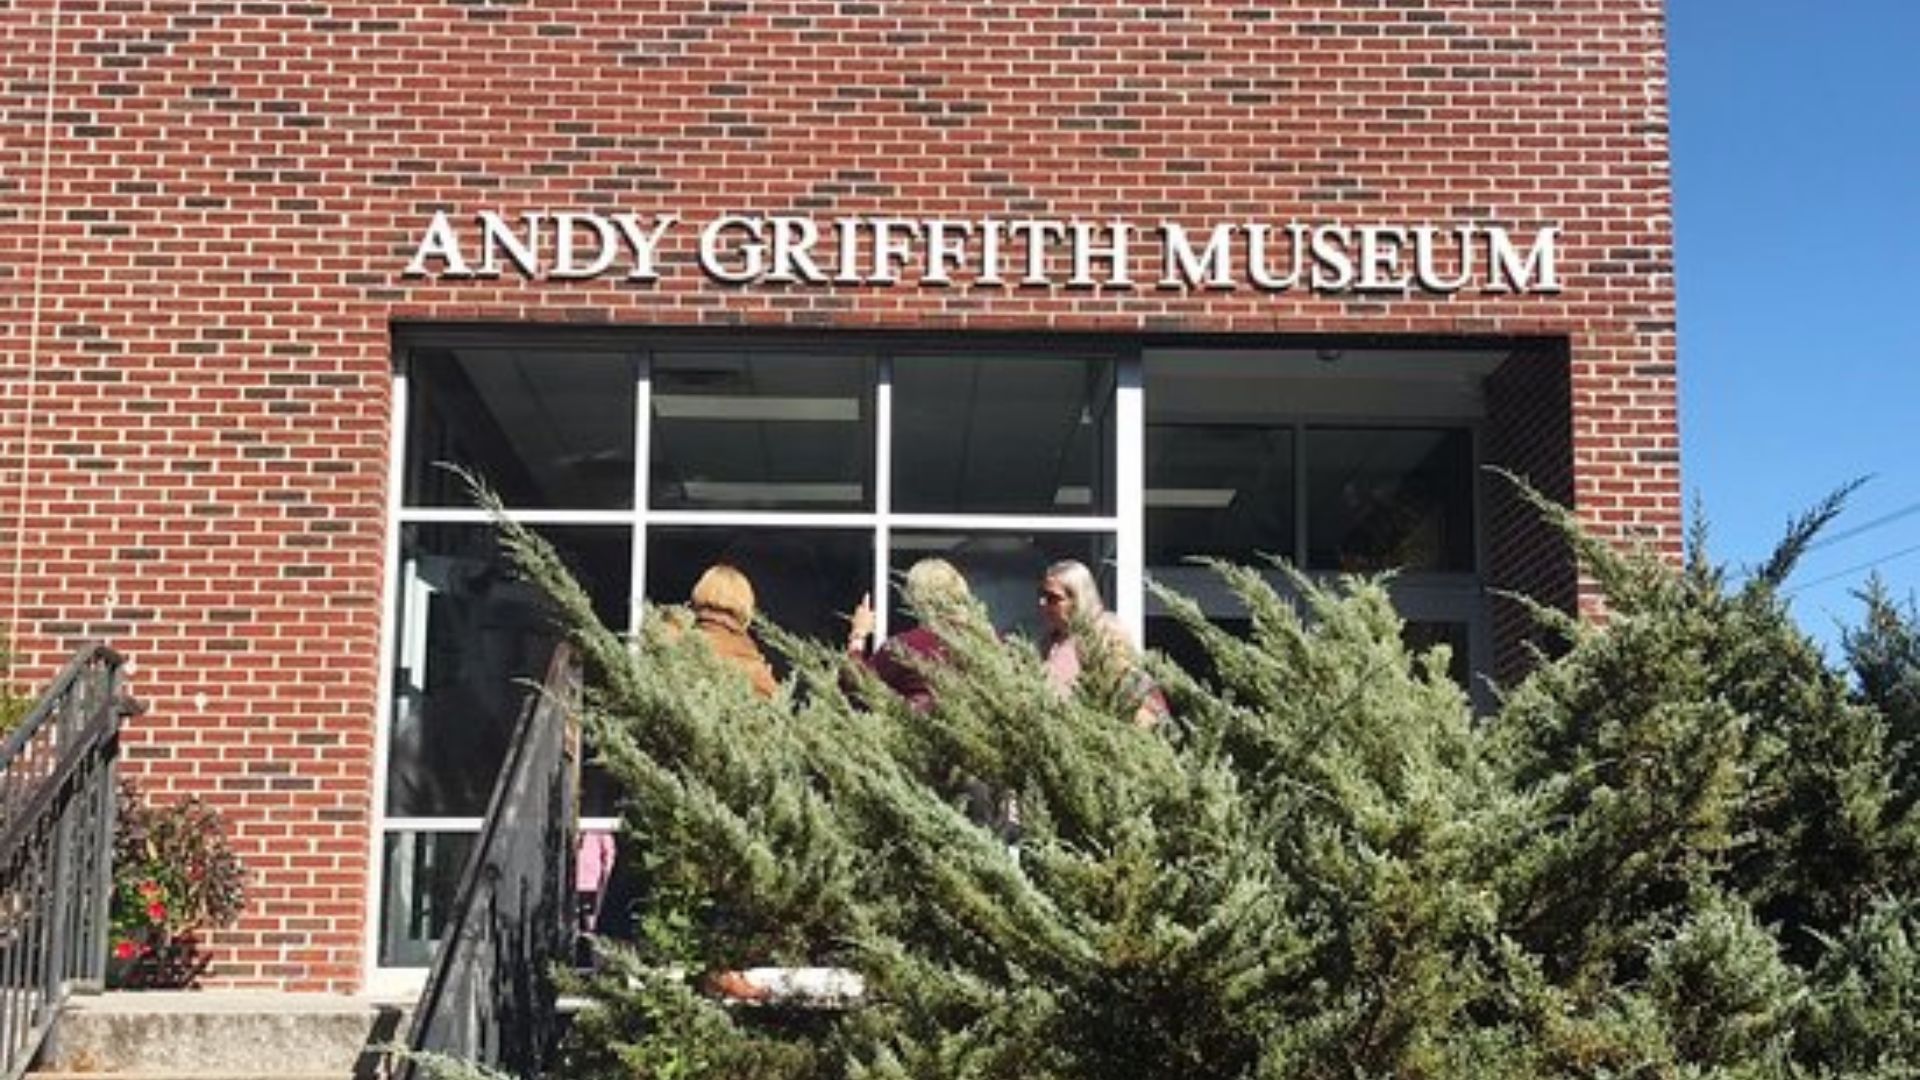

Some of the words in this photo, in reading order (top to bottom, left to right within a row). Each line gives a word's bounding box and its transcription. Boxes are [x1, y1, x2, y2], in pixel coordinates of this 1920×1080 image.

[405, 210, 678, 281] ANDY
[700, 214, 1132, 287] GRIFFITH
[1158, 221, 1561, 292] MUSEUM
